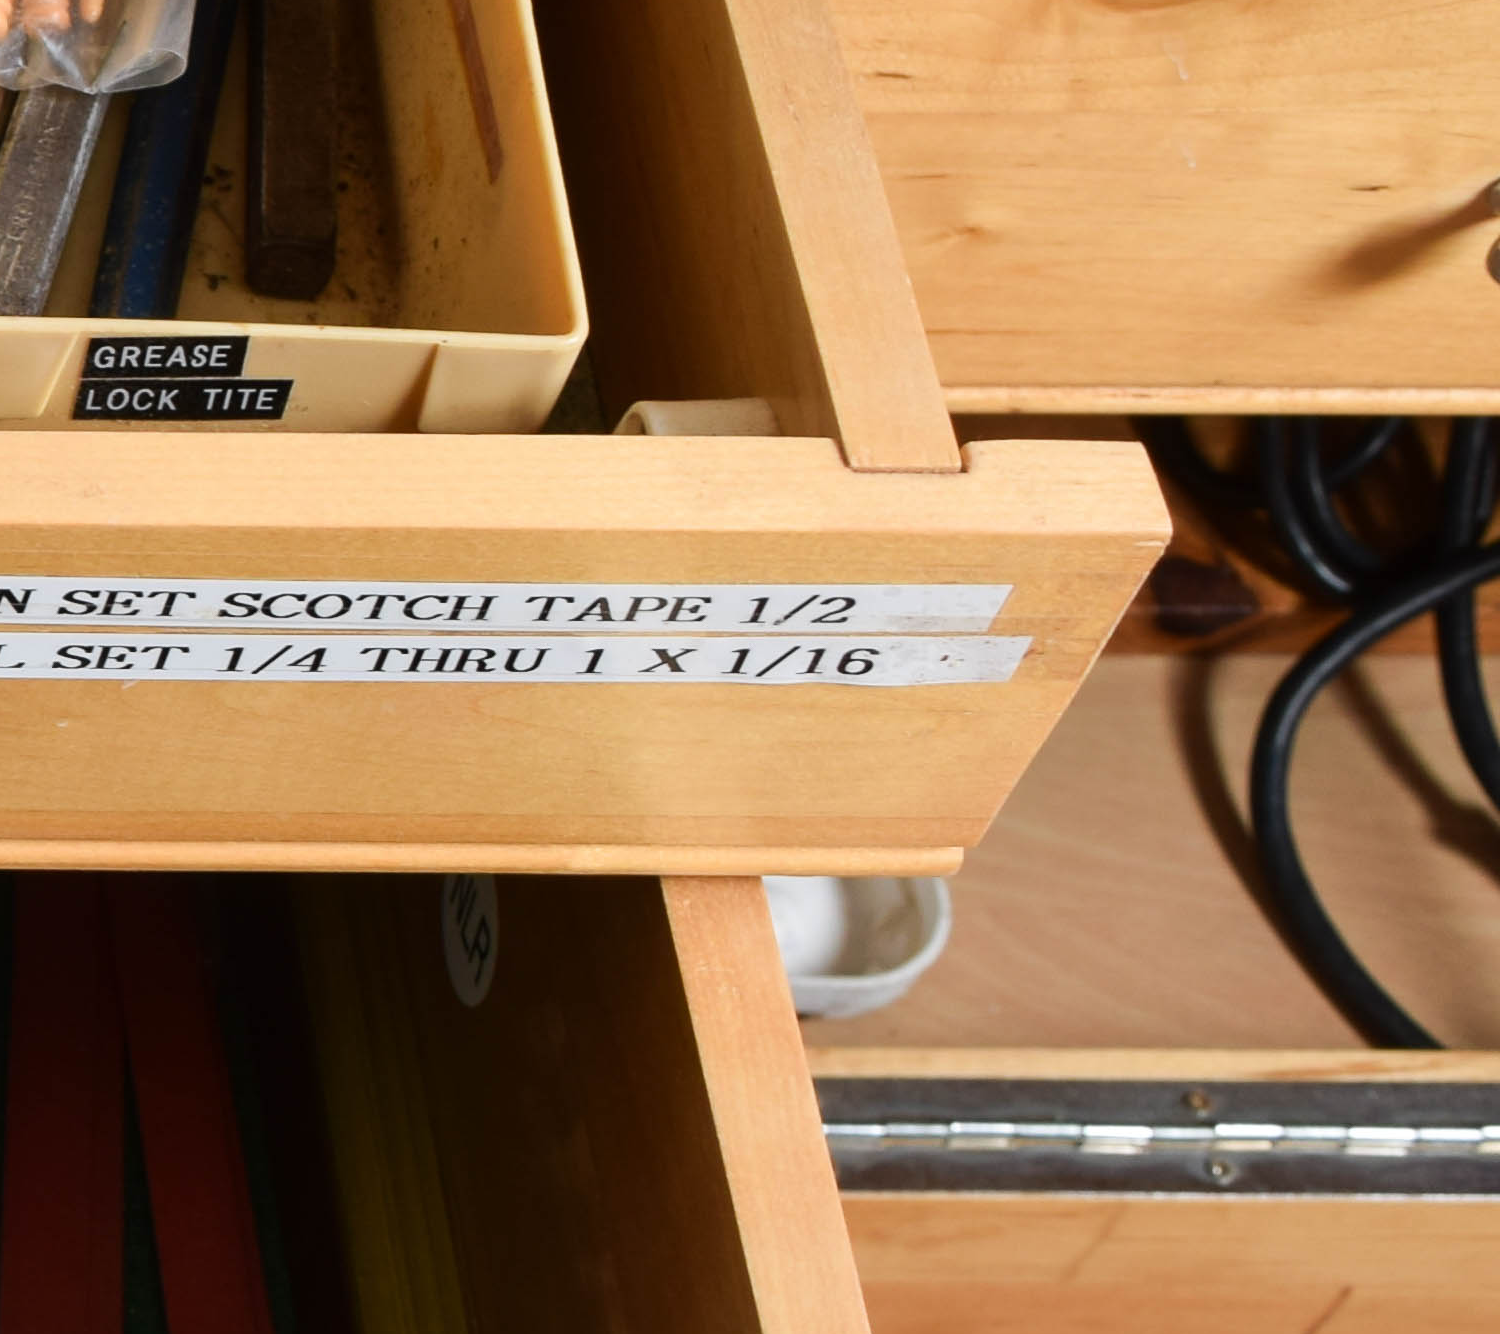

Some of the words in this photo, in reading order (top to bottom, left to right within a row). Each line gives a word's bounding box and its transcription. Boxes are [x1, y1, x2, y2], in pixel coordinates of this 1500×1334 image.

[94, 345, 231, 368] GREASE
[86, 388, 179, 411] LOCK
[203, 389, 278, 410] TITE
[56, 588, 197, 619] SET
[217, 591, 498, 622] SCOTCH
[526, 596, 713, 624] TAPE
[743, 596, 857, 625] 1/2
[50, 644, 189, 670] SET
[215, 646, 327, 673] 1/4
[360, 647, 551, 674] THRU
[584, 648, 606, 674] 1
[639, 648, 695, 675] X
[729, 649, 884, 676] 1/16
